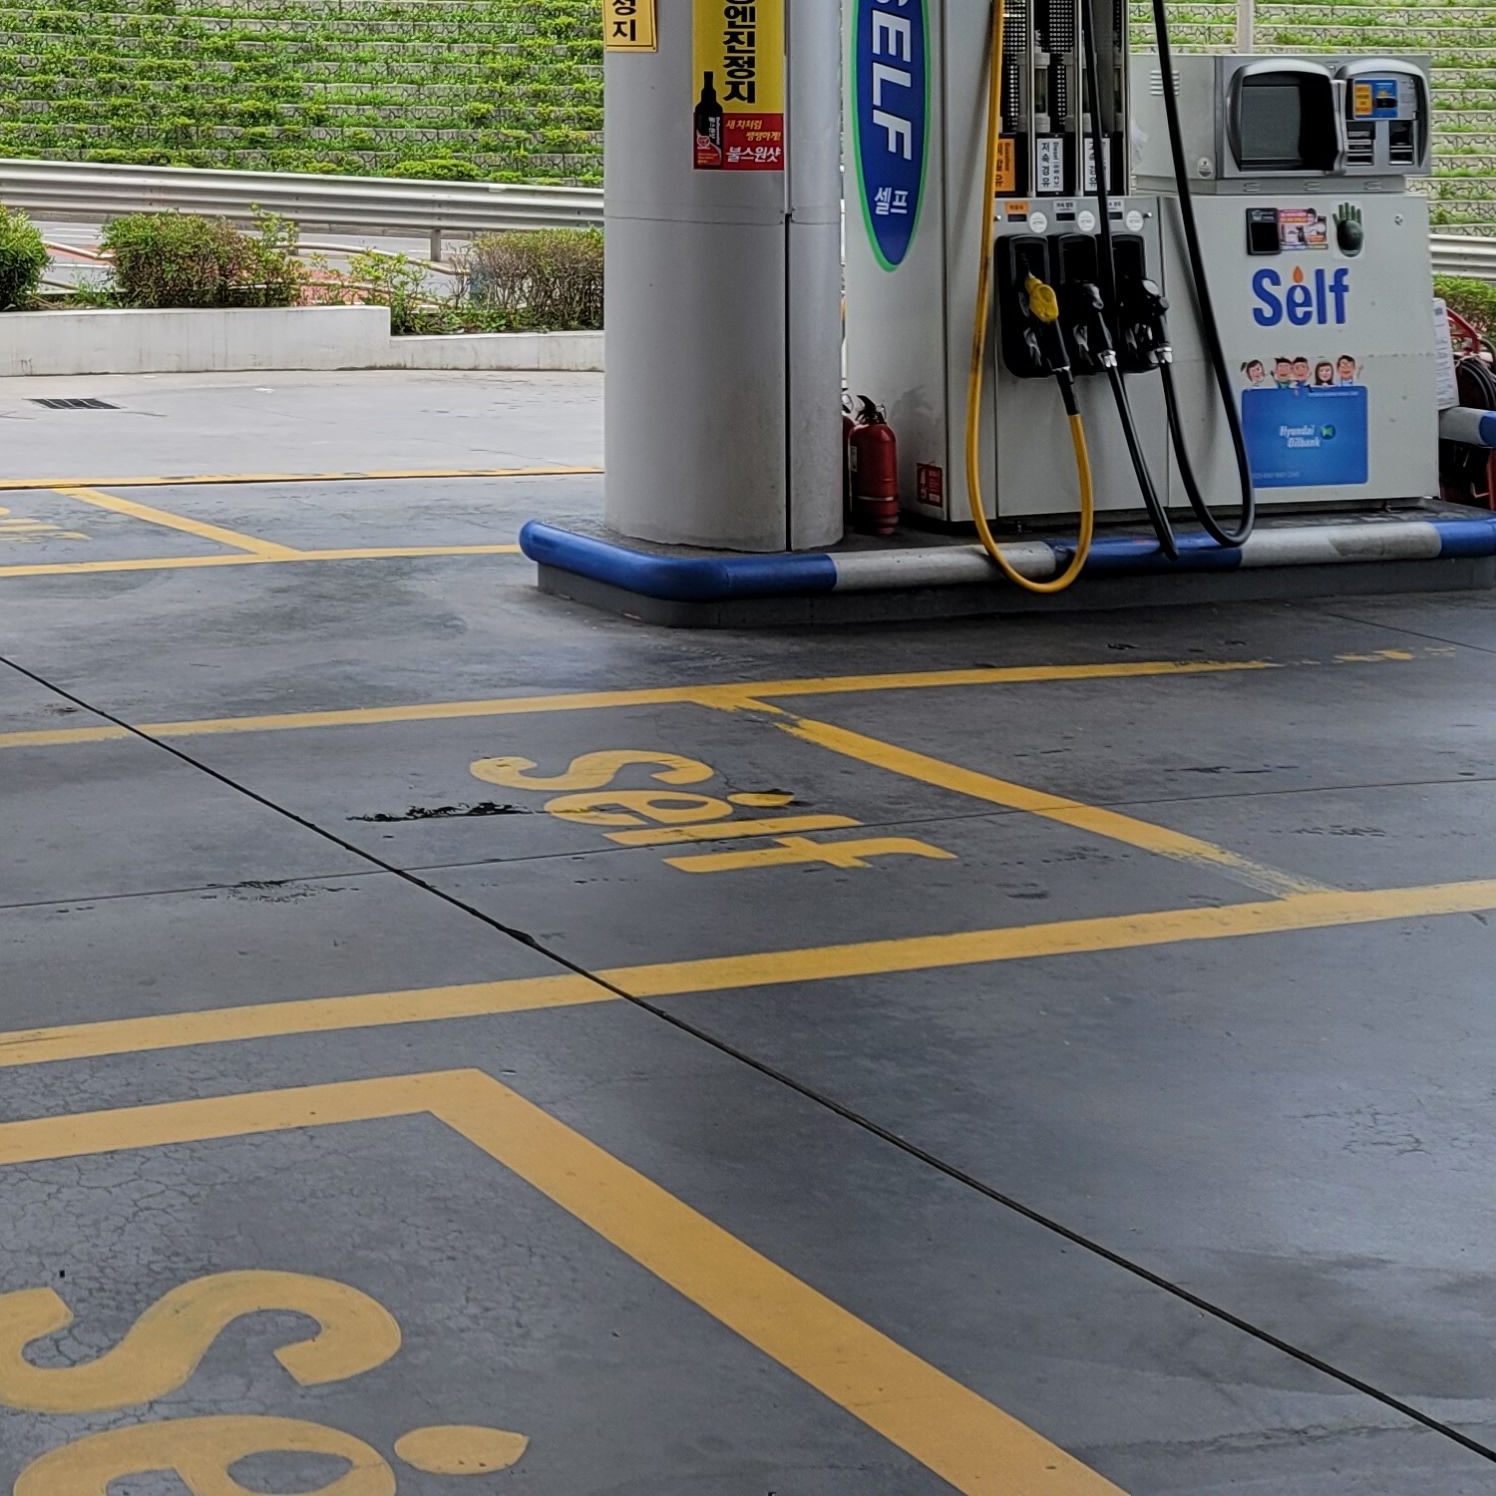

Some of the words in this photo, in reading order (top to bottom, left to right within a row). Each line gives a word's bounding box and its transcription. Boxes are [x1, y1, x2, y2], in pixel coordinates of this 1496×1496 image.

[726, 146, 781, 163] 불스원샷
[874, 186, 909, 216] 셀프
[1252, 266, 1350, 326] Self
[1278, 423, 1315, 438] Hyundai
[1286, 436, 1321, 449] Oilbank
[470, 749, 958, 872] Self
